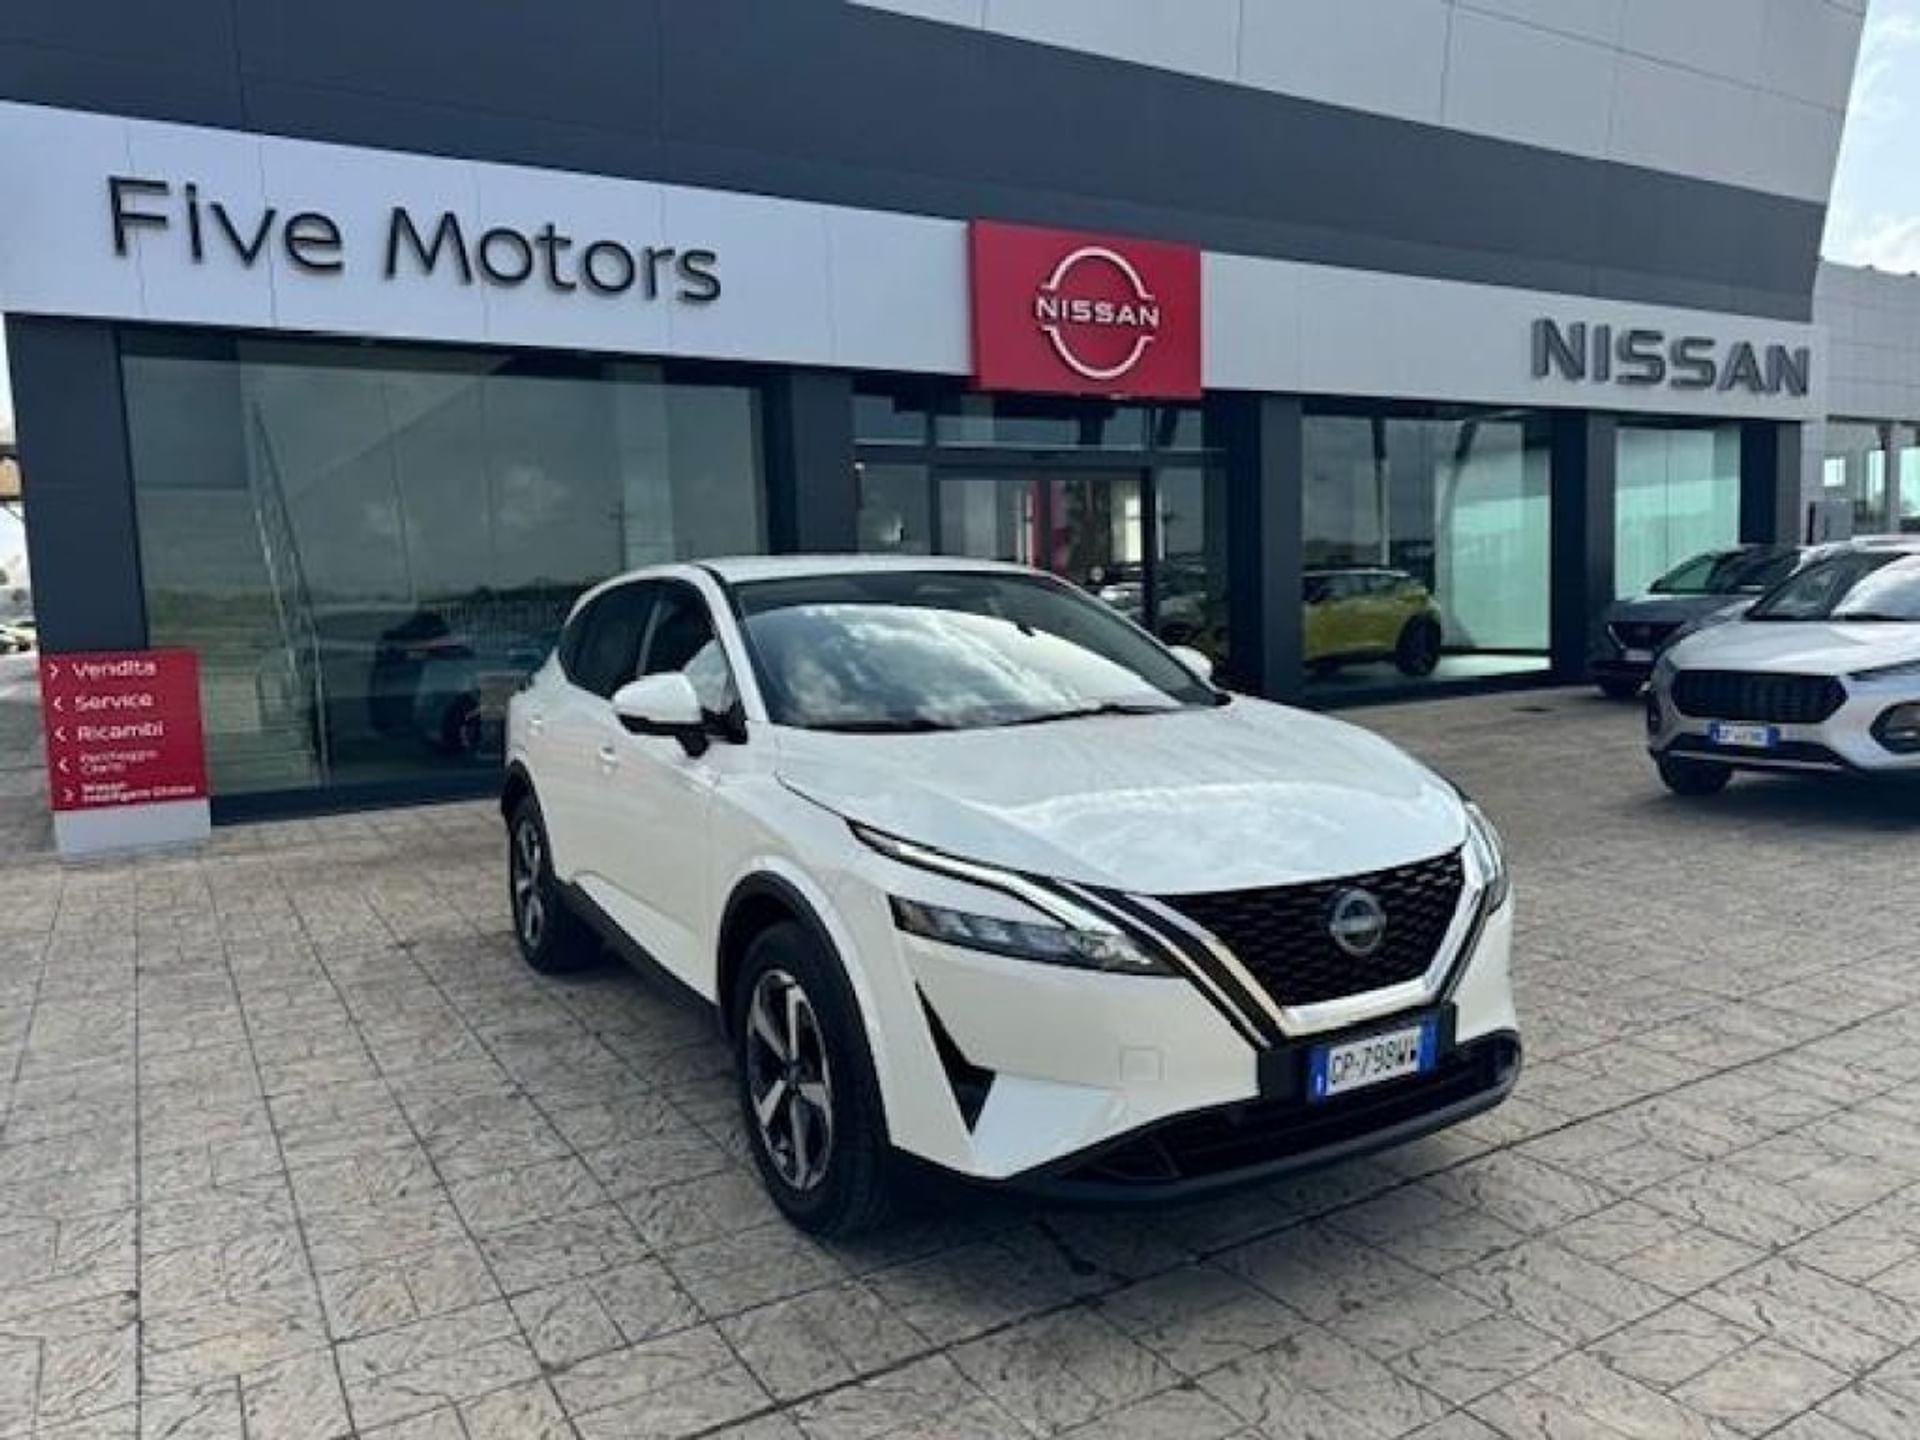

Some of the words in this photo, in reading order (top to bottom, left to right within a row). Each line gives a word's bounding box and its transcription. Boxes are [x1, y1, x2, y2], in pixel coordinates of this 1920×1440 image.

[109, 174, 344, 273] Five
[384, 206, 722, 302] Motors
[1037, 296, 1159, 327] NISSAN
[1531, 318, 1811, 396] NISSAN
[72, 660, 157, 680] Vendita
[75, 692, 153, 712] Service
[78, 720, 164, 742] Ricambi
